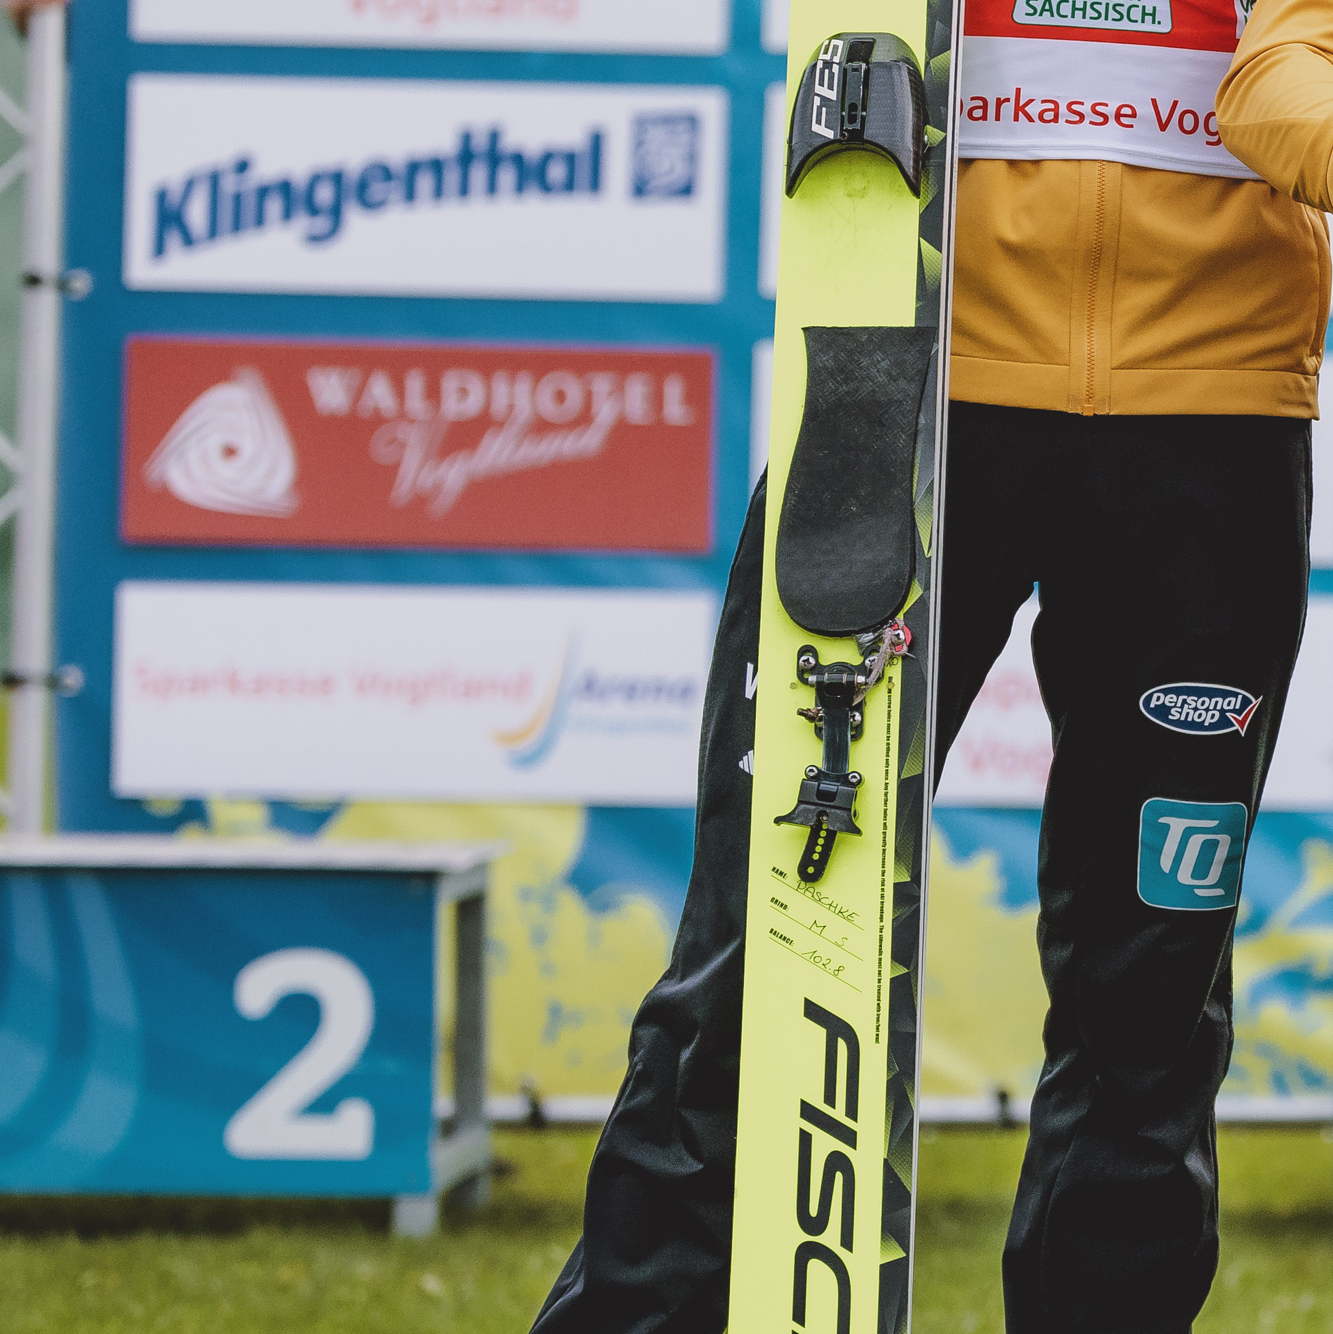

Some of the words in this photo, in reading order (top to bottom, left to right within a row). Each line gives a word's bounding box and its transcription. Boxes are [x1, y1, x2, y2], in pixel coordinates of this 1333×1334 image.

[811, 39, 844, 140] FES
[955, 87, 1138, 129] arkasse
[151, 126, 606, 263] Klingenthal
[306, 366, 696, 426] WALDHOTEL
[1149, 691, 1243, 714] personal
[1168, 704, 1220, 727] shop
[770, 866, 788, 880] NAME:
[1156, 815, 1234, 899] TQ
[769, 896, 790, 912] GRIND:
[768, 927, 796, 948] BALANCE:
[808, 919, 828, 936] M
[223, 946, 377, 1162] 2
